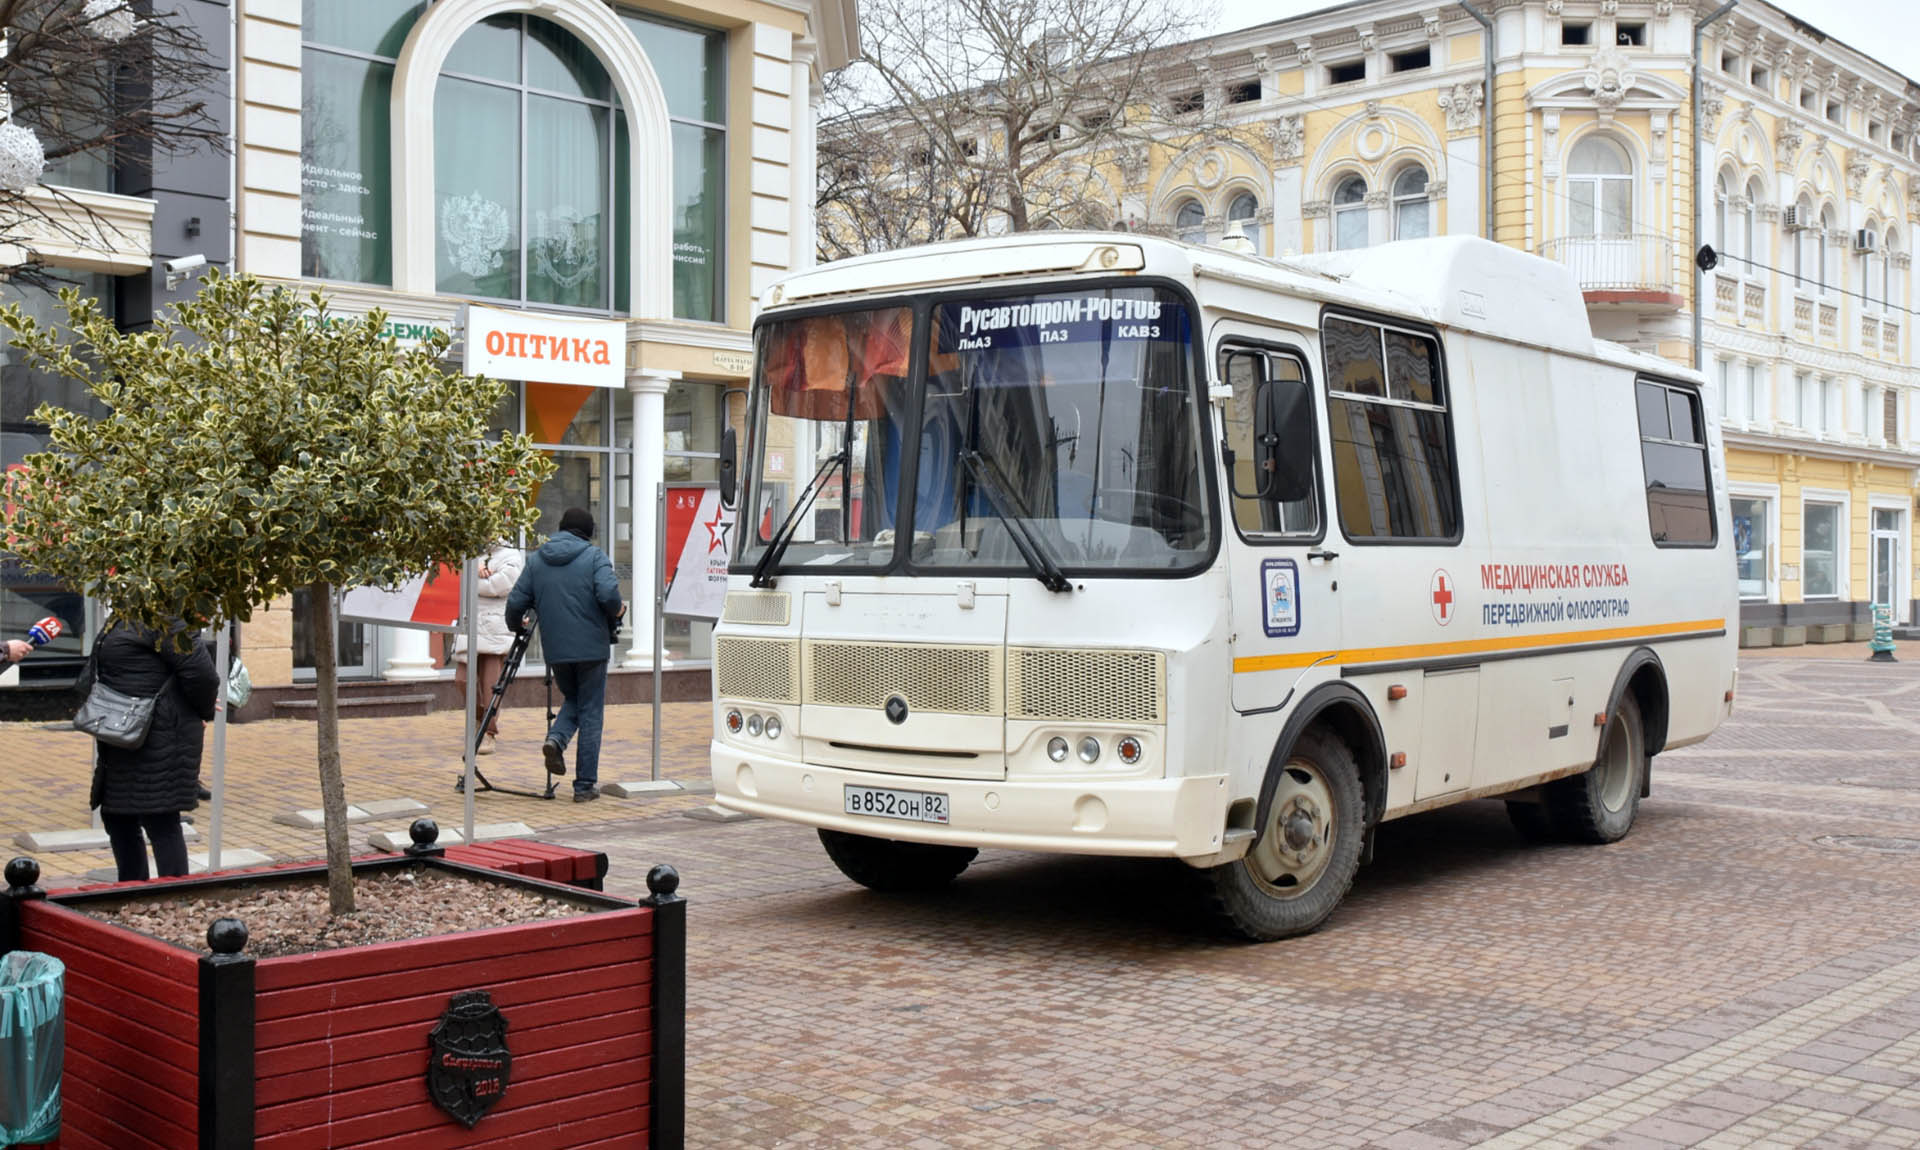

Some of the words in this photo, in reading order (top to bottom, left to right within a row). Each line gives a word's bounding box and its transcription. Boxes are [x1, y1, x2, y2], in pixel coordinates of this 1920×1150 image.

[302, 163, 362, 181] Идеальное
[302, 178, 328, 189] есто
[337, 183, 370, 195] здесь
[339, 227, 378, 240] сейчас
[958, 336, 992, 351] ЛиАЗ
[1040, 330, 1068, 343] ПАЗ
[1118, 325, 1160, 338] КАВЗ
[1480, 564, 1581, 594] МЕДИЦИНСКАЯ
[1583, 563, 1629, 588] СЛУЖБА
[1482, 596, 1564, 628] ПЕРЕДВИЖНОЙ
[1566, 598, 1630, 621] ФЛЮОРОГРАФ
[924, 796, 943, 813] 82
